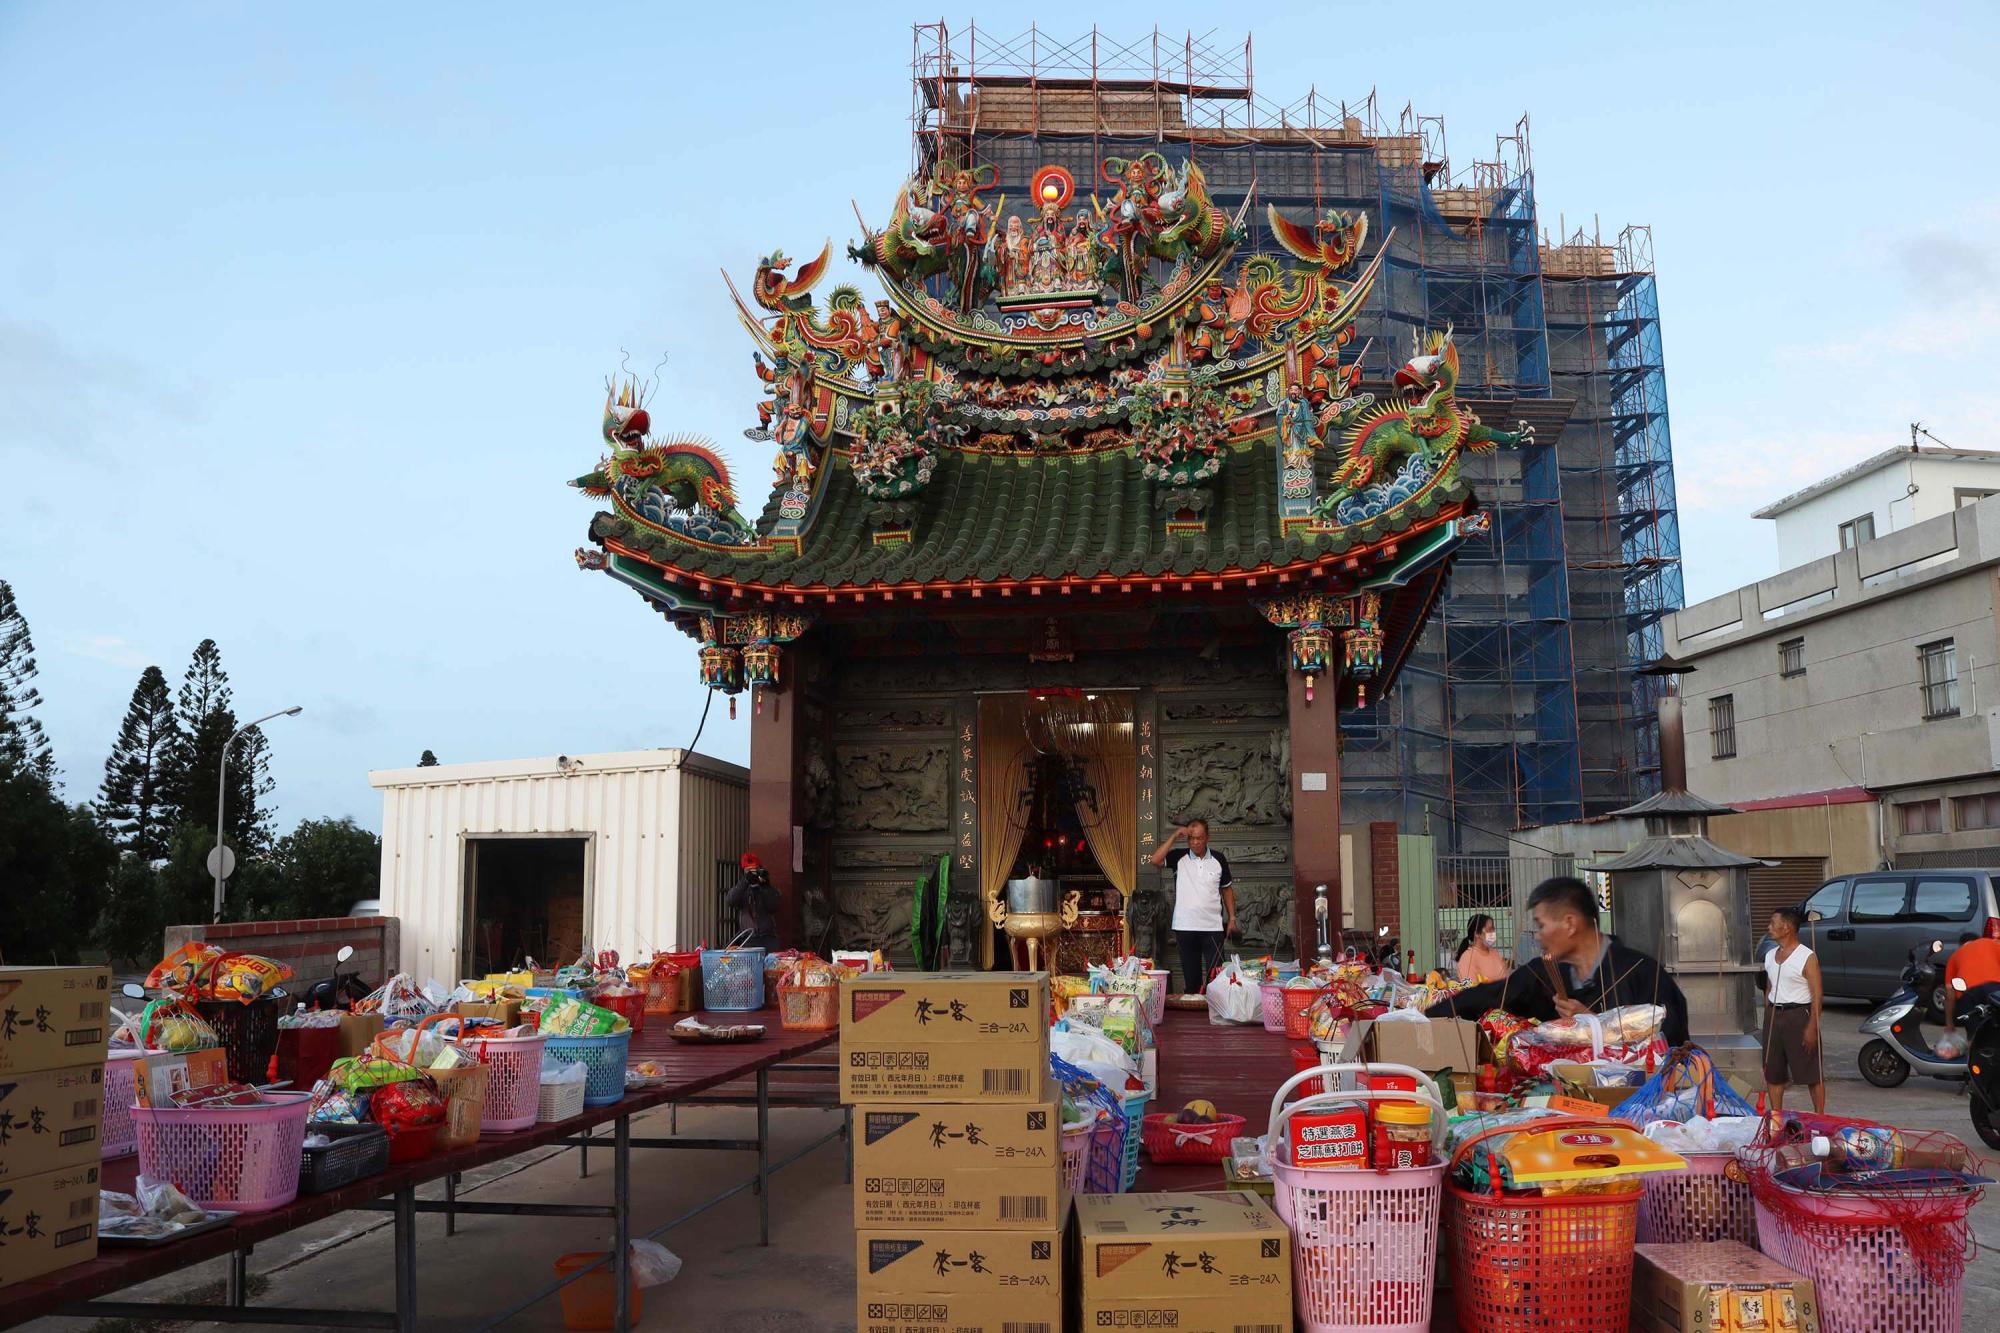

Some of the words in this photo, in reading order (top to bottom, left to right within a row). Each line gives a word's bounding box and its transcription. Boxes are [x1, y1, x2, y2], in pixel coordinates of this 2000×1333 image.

[1012, 999, 1018, 1007] 9
[914, 997, 974, 1026] 來一客
[1, 1004, 56, 1041] 來一客
[978, 1022, 1030, 1033] 三合一24入
[1029, 1121, 1035, 1129] 9
[929, 1121, 989, 1150] 來一客
[1302, 1123, 1357, 1141] 特選燕麥
[994, 1146, 1046, 1158] 三合一24入
[1297, 1141, 1364, 1159] 芝麻蘇打餅
[1034, 1250, 1040, 1258] 9
[933, 1248, 993, 1277] 來一客
[1162, 1250, 1223, 1279] 來一客
[998, 1275, 1050, 1286] 三合一24入
[1229, 1274, 1281, 1286] 三合一24入
[1803, 1302, 1811, 1315] 8
[1694, 1310, 1703, 1323] 8
